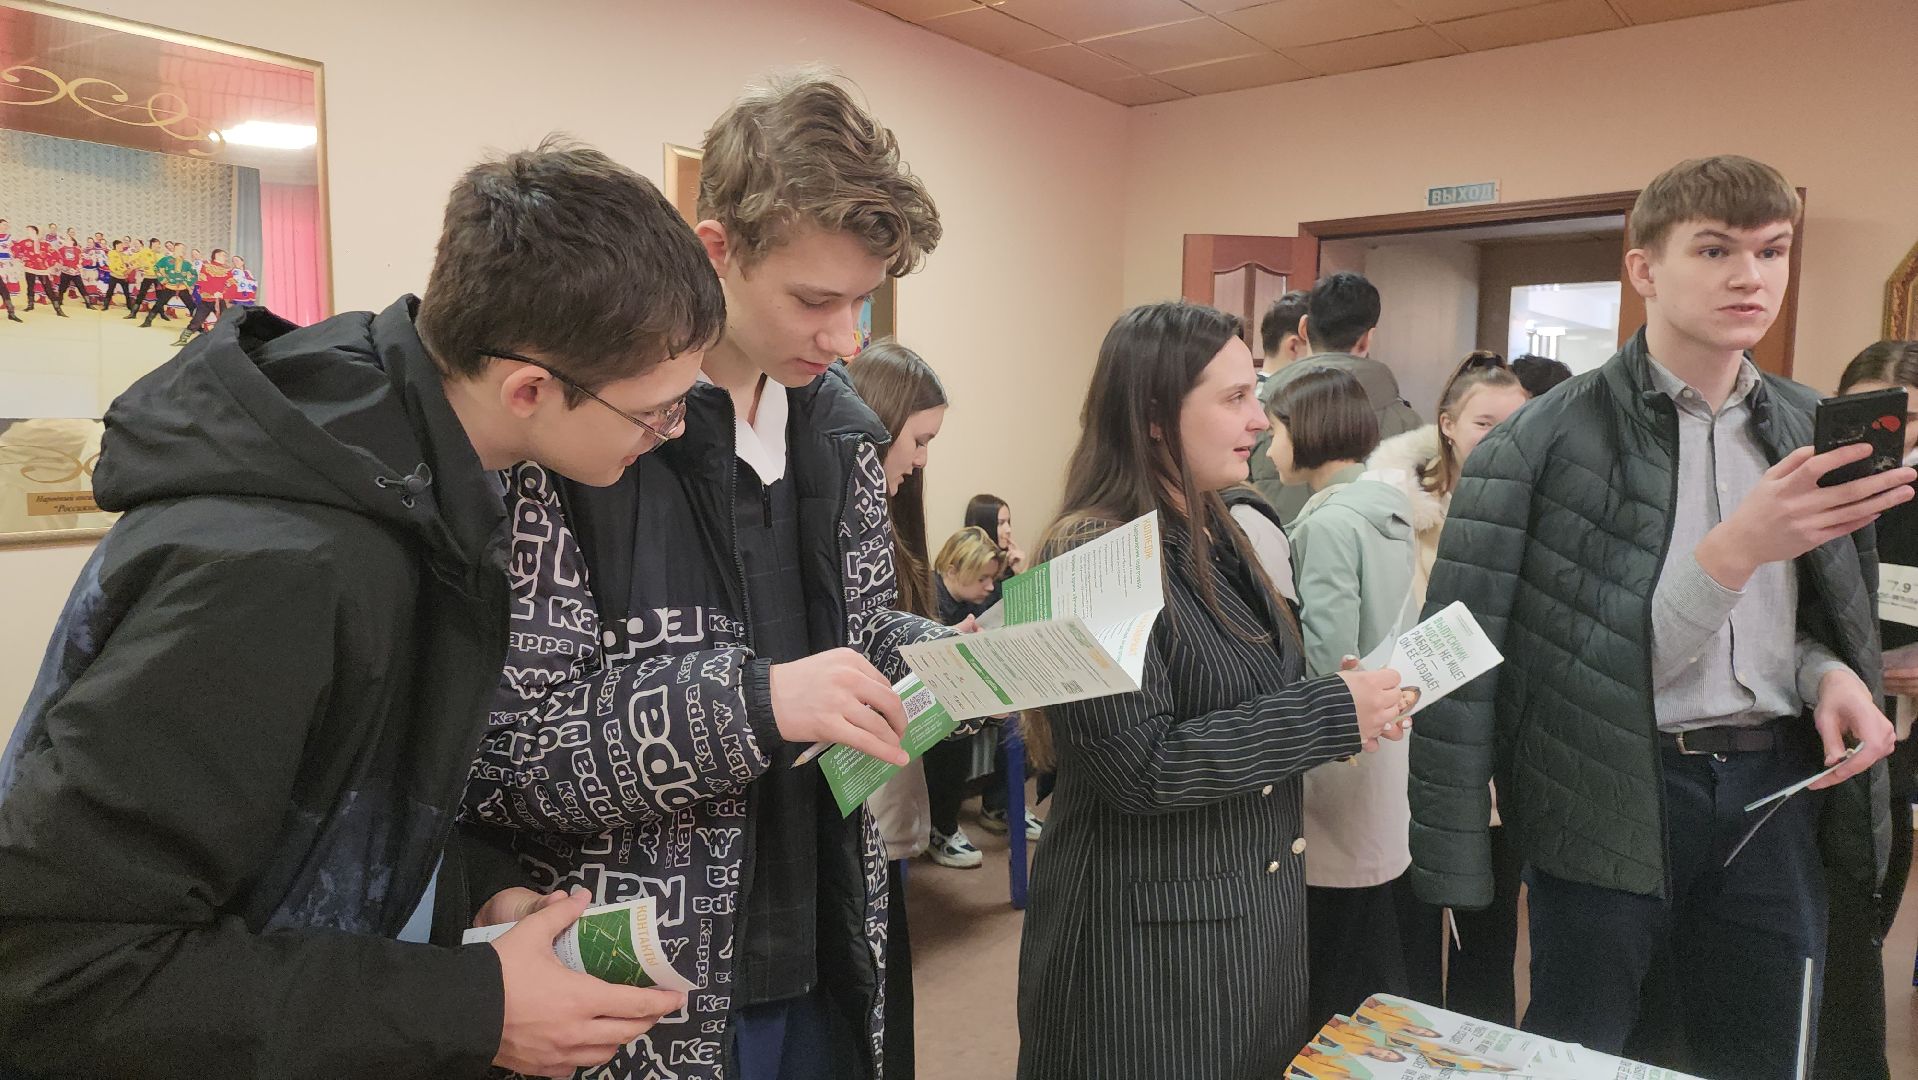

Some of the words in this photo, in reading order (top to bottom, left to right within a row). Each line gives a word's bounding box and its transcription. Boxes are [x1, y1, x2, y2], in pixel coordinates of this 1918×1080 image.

[1431, 183, 1493, 205] ВЫХОД
[509, 631, 574, 655] appa
[709, 614, 746, 638] Kap
[1399, 637, 1410, 649] ОН
[1410, 630, 1434, 658] РАБОТУ
[1433, 616, 1470, 661] ВЫПУСКНИК
[1438, 648, 1453, 662] НЕ
[1446, 659, 1466, 681] ИЩЕТ
[628, 684, 708, 812] ppa
[686, 683, 718, 773] Kappa
[603, 718, 650, 812] Kappa
[675, 806, 695, 868] Kap
[636, 905, 658, 967] КОНТАКТЫ
[696, 918, 713, 990] Kappa
